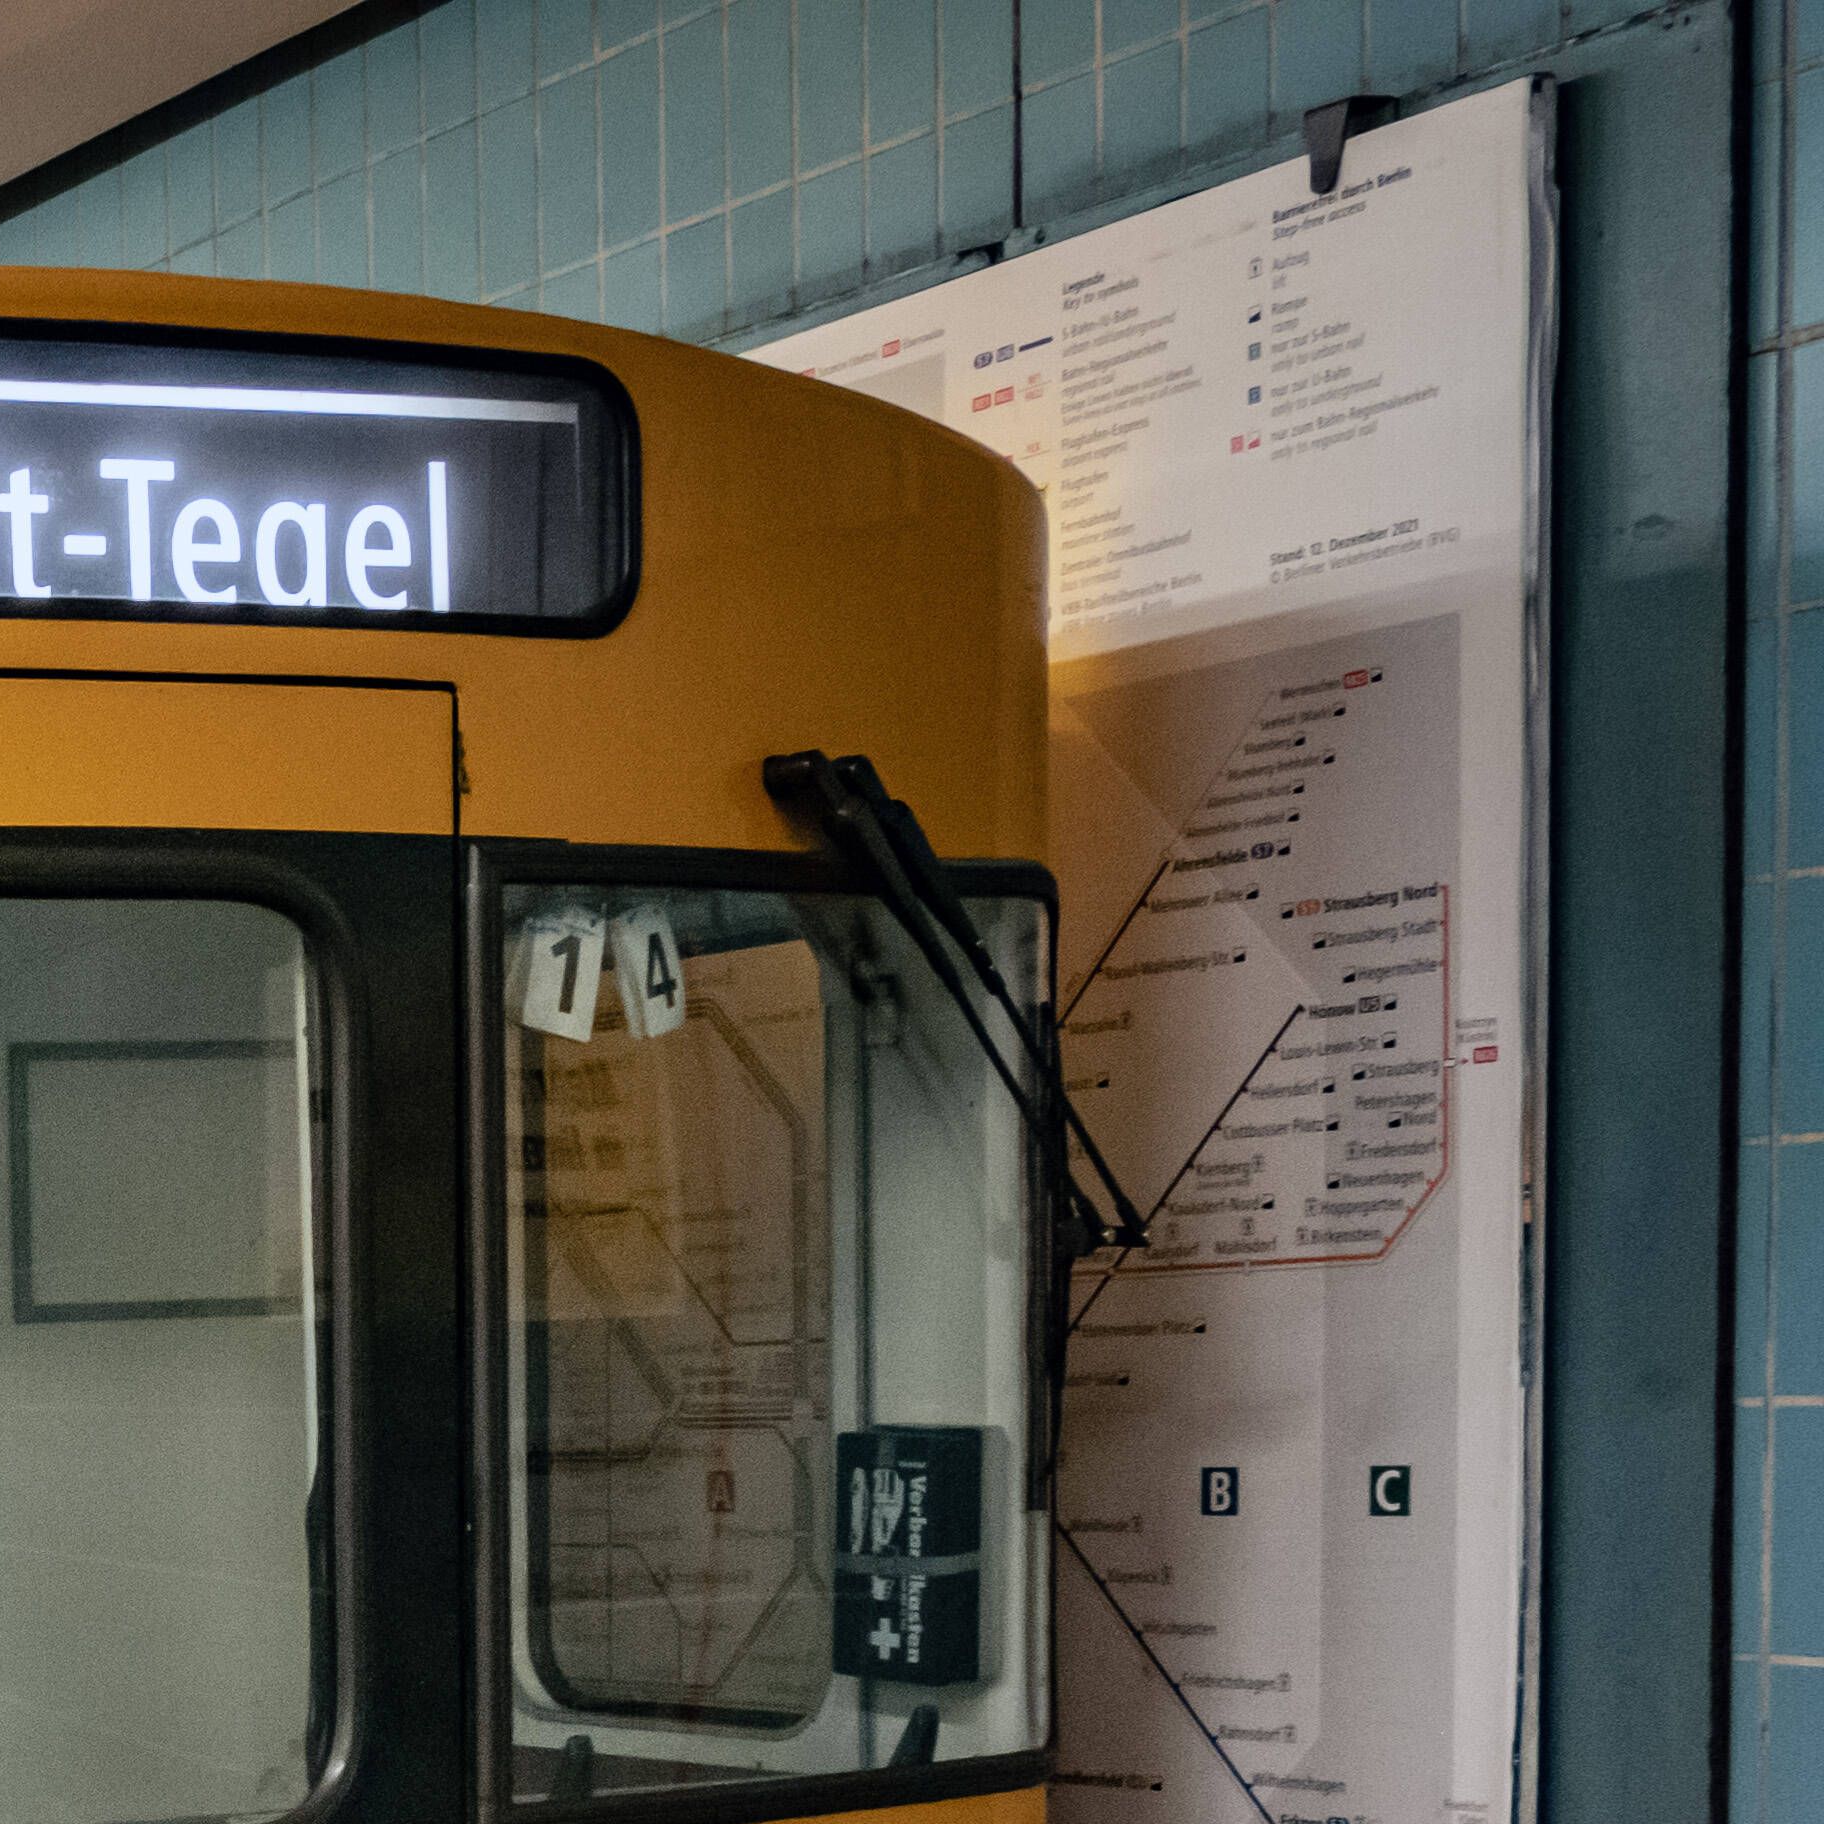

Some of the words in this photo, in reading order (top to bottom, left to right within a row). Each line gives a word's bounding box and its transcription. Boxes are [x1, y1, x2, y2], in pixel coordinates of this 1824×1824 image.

[1341, 179, 1374, 199] durch
[1377, 167, 1412, 188] Berlin
[1328, 201, 1367, 222] access
[1063, 273, 1105, 295] Legende
[1329, 528, 1389, 552] Dezember
[1392, 518, 1419, 537] 2021
[1284, 562, 1325, 581] Berliner
[1426, 527, 1461, 547] (BVG)
[1172, 849, 1249, 873] Ahrensfelde
[1324, 891, 1399, 914] Strausberg
[1403, 882, 1438, 900] Nord
[1327, 926, 1399, 948] Strausberg
[1402, 920, 1437, 937] Stadt
[551, 935, 581, 1014] 1
[647, 932, 677, 1009] 4
[1367, 1060, 1440, 1079] Strausberg
[1355, 1092, 1437, 1110] Petershagen
[1361, 1137, 1437, 1158] Fredersdorf
[1209, 1471, 1232, 1512] B
[1374, 1469, 1402, 1512] C
